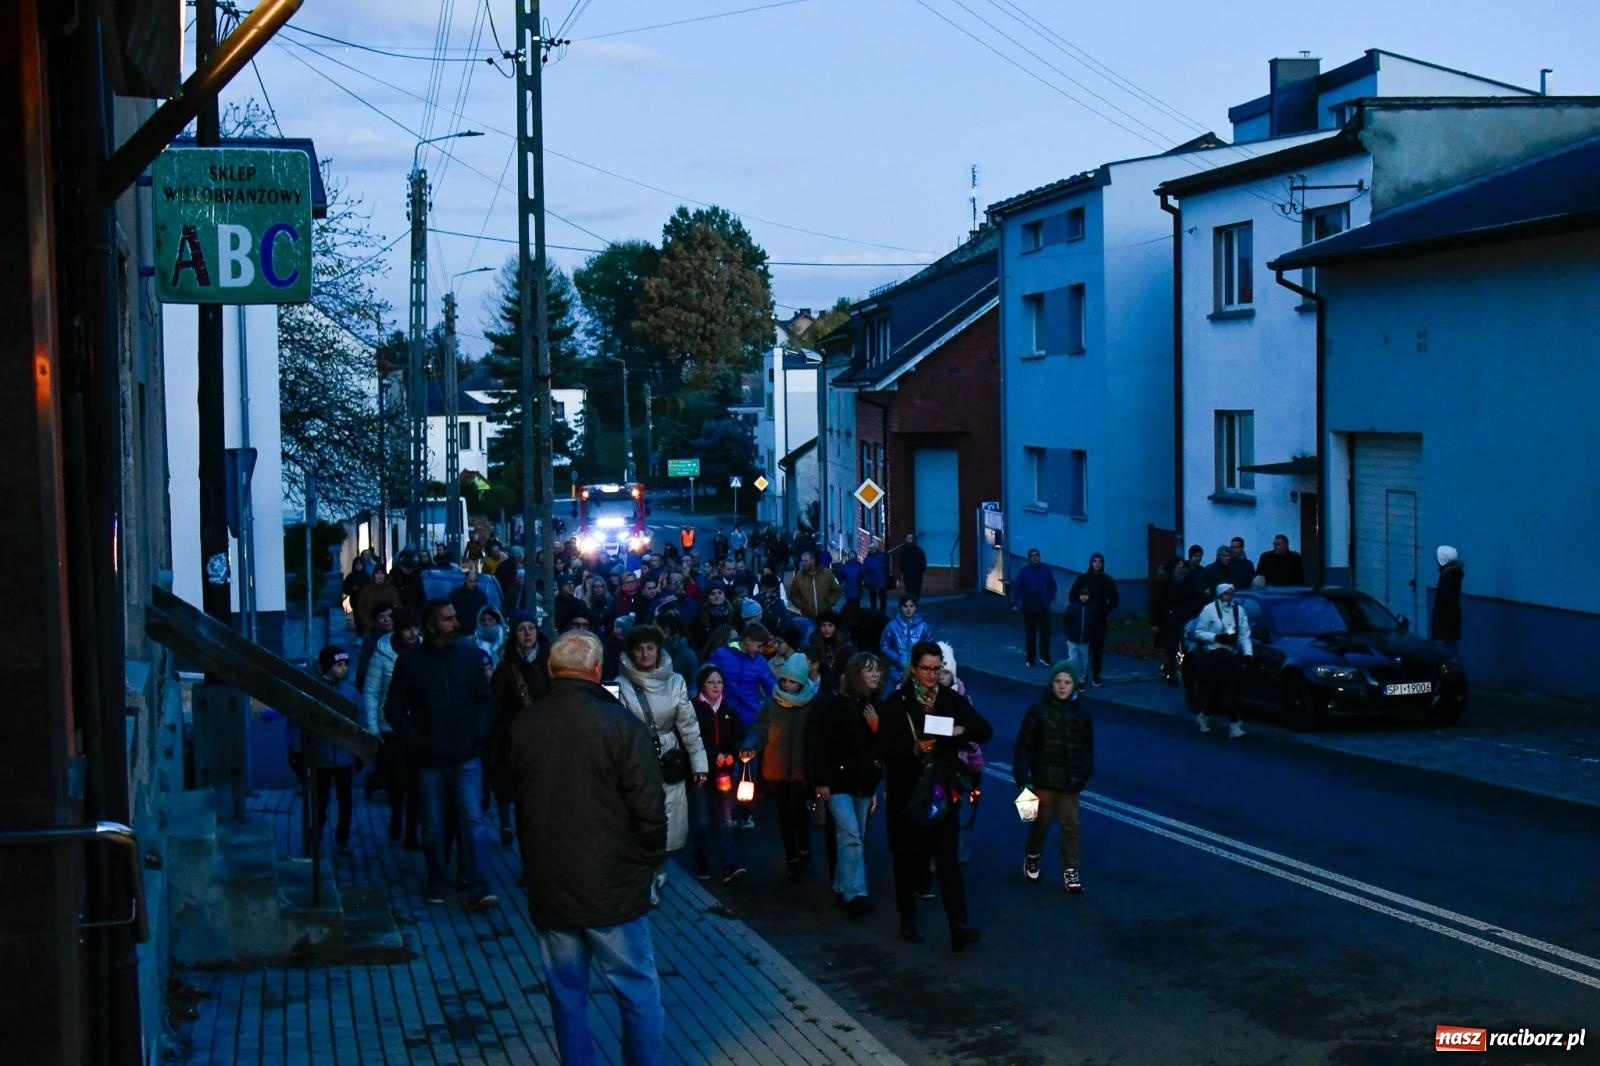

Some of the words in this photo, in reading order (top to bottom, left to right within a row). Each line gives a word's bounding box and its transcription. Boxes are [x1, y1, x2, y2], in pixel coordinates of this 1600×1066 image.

[209, 165, 256, 182] SKLEP
[163, 184, 301, 205] WIELOBRANŻOWY
[171, 221, 300, 289] ABC
